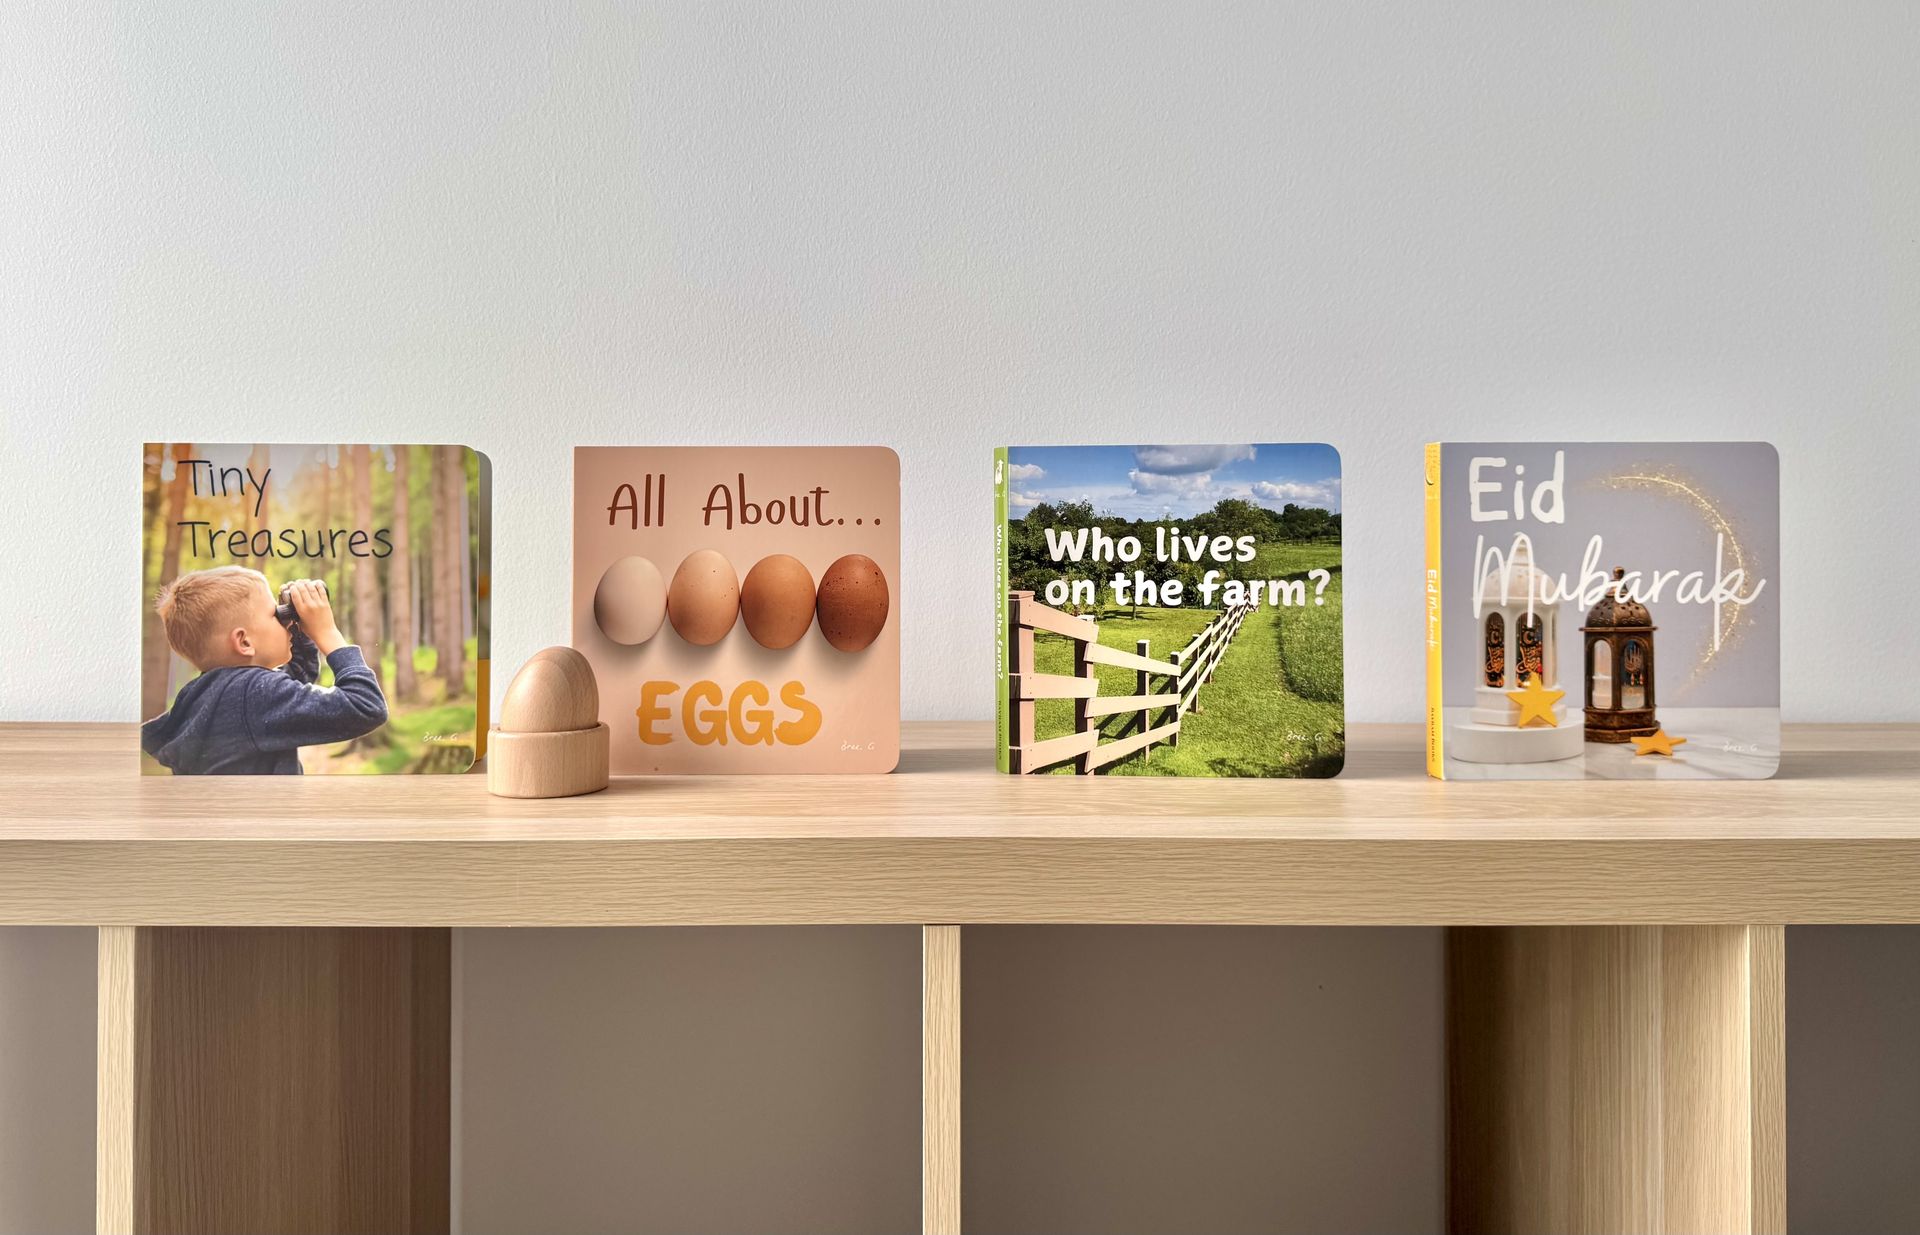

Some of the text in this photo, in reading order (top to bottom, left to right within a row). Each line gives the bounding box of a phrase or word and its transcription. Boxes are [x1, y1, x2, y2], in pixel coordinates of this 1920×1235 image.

[177, 459, 272, 517] Tiny
[607, 472, 881, 530] All About...
[1468, 449, 1565, 524] Eid
[176, 521, 394, 559] Treasures
[1044, 526, 1257, 563] Who lives
[996, 592, 1003, 608] on
[1044, 568, 1332, 608] on the farm?
[1427, 569, 1438, 592] Eid
[1471, 531, 1767, 652] Mubarak
[996, 613, 1004, 635] the
[996, 639, 1004, 679] farm?
[635, 679, 822, 746] EGGS
